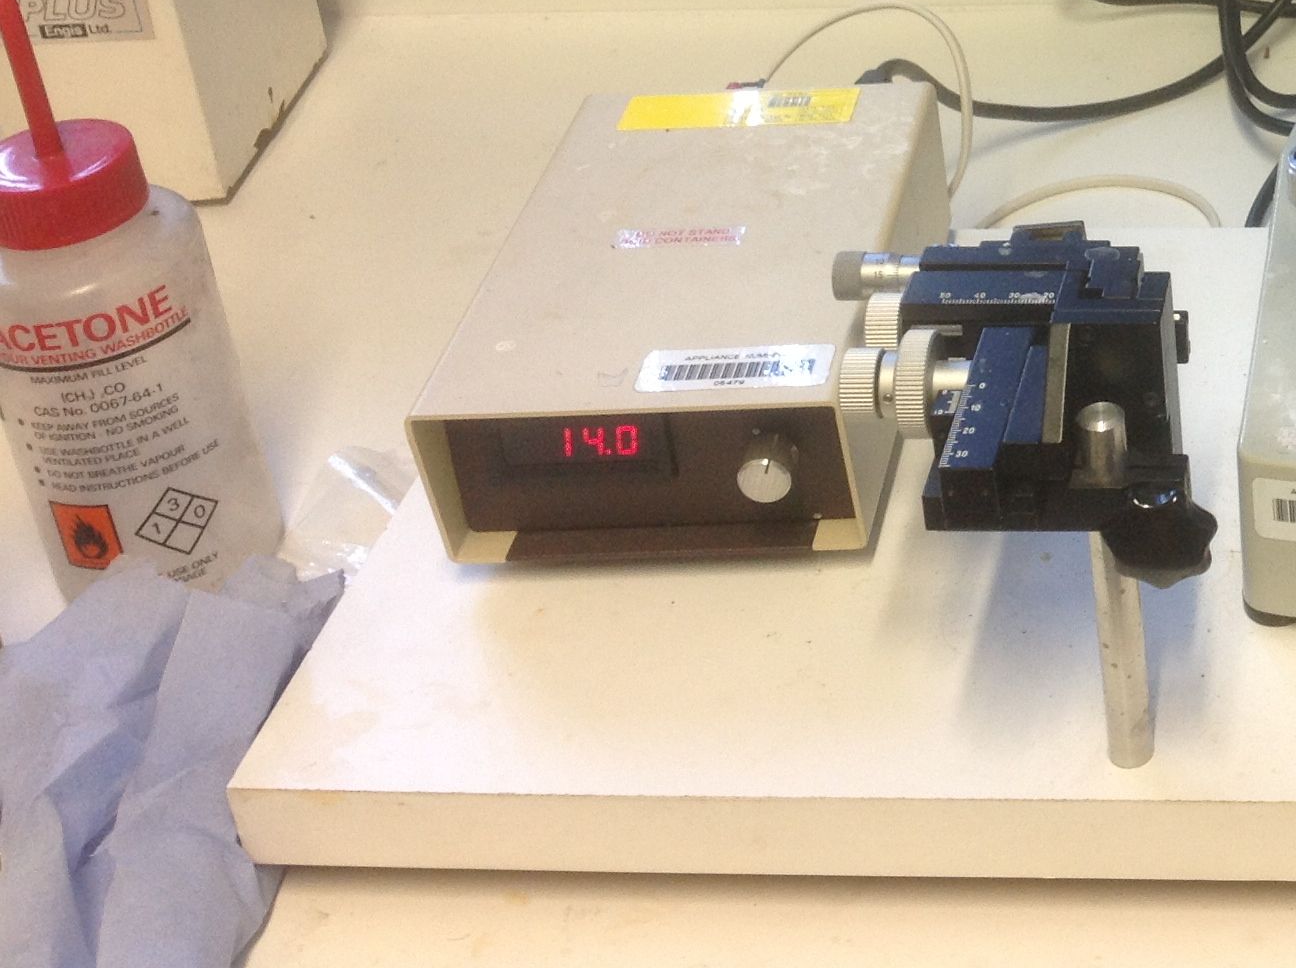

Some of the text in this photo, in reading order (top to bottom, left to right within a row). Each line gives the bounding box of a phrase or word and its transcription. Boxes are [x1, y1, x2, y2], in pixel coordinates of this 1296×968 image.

[655, 235, 736, 245] CONTAINERS
[659, 230, 684, 238] NOT
[689, 228, 729, 236] STAND
[30, 348, 96, 366] VENTING
[101, 305, 188, 355] WASHBOTTLE
[30, 356, 148, 385] MAXIMUM FILL LEVEL
[684, 354, 740, 362] APPLIANCE
[31, 393, 180, 432] KEEP AWAY FROM SOURCES
[34, 406, 60, 418] CAS
[90, 383, 164, 413] 0067-64-1
[34, 406, 179, 441] OF IGNITION NO SMOKING
[60, 440, 133, 457] WASHBOTTLE
[137, 435, 149, 445] IN
[152, 431, 161, 439] A
[163, 417, 190, 435] WELL
[962, 426, 975, 435] 20
[564, 425, 637, 456] 14.0
[955, 450, 969, 458] 30
[43, 448, 141, 466] VENTILATED PLACE
[64, 470, 84, 479] NOT
[88, 463, 138, 479] BREATHE
[141, 444, 185, 468] VAPOUR
[79, 471, 160, 493] INSTRUCTIONS
[162, 451, 200, 475] BEFORE
[201, 438, 220, 456] USE
[167, 497, 180, 512] 3
[193, 504, 206, 519] 0
